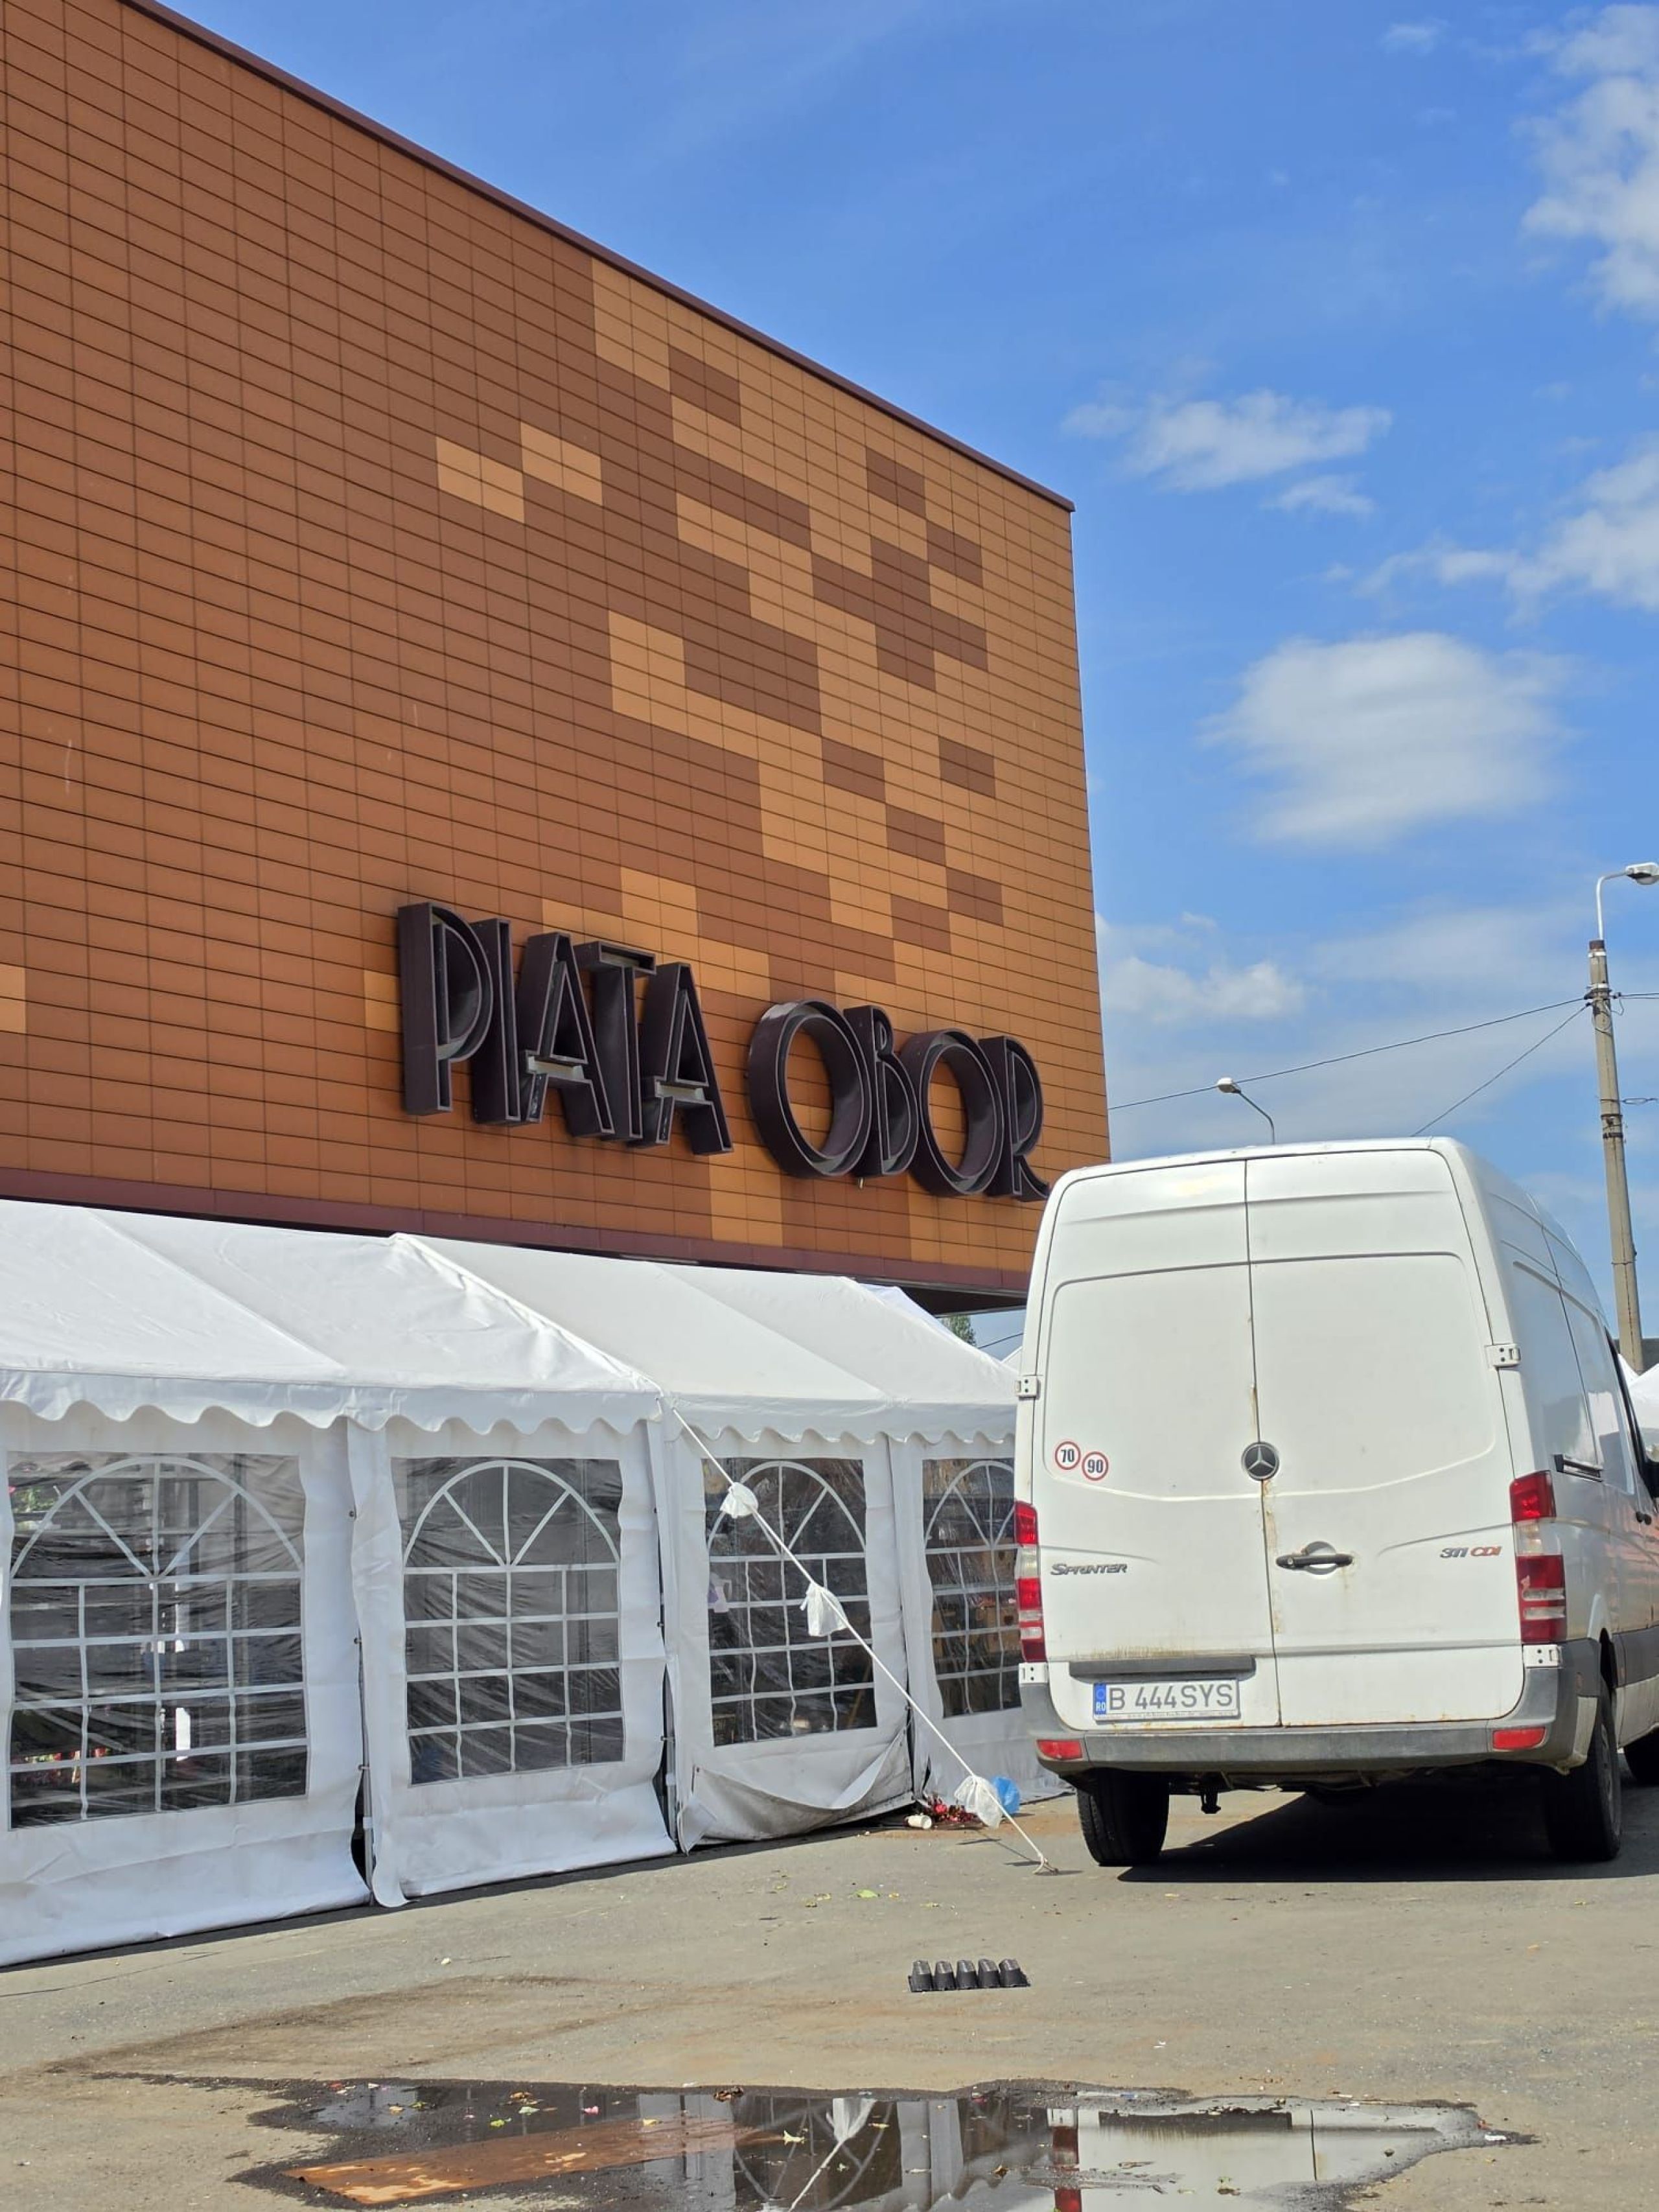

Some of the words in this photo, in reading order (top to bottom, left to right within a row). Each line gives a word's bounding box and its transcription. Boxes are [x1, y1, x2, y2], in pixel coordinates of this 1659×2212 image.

[398, 902, 732, 1156] PIATA
[747, 999, 1049, 1202] OBOR
[1060, 1448, 1074, 1463] 70
[1087, 1459, 1104, 1474] 90
[1470, 1546, 1502, 1557] CDI
[1109, 1687, 1126, 1710] B
